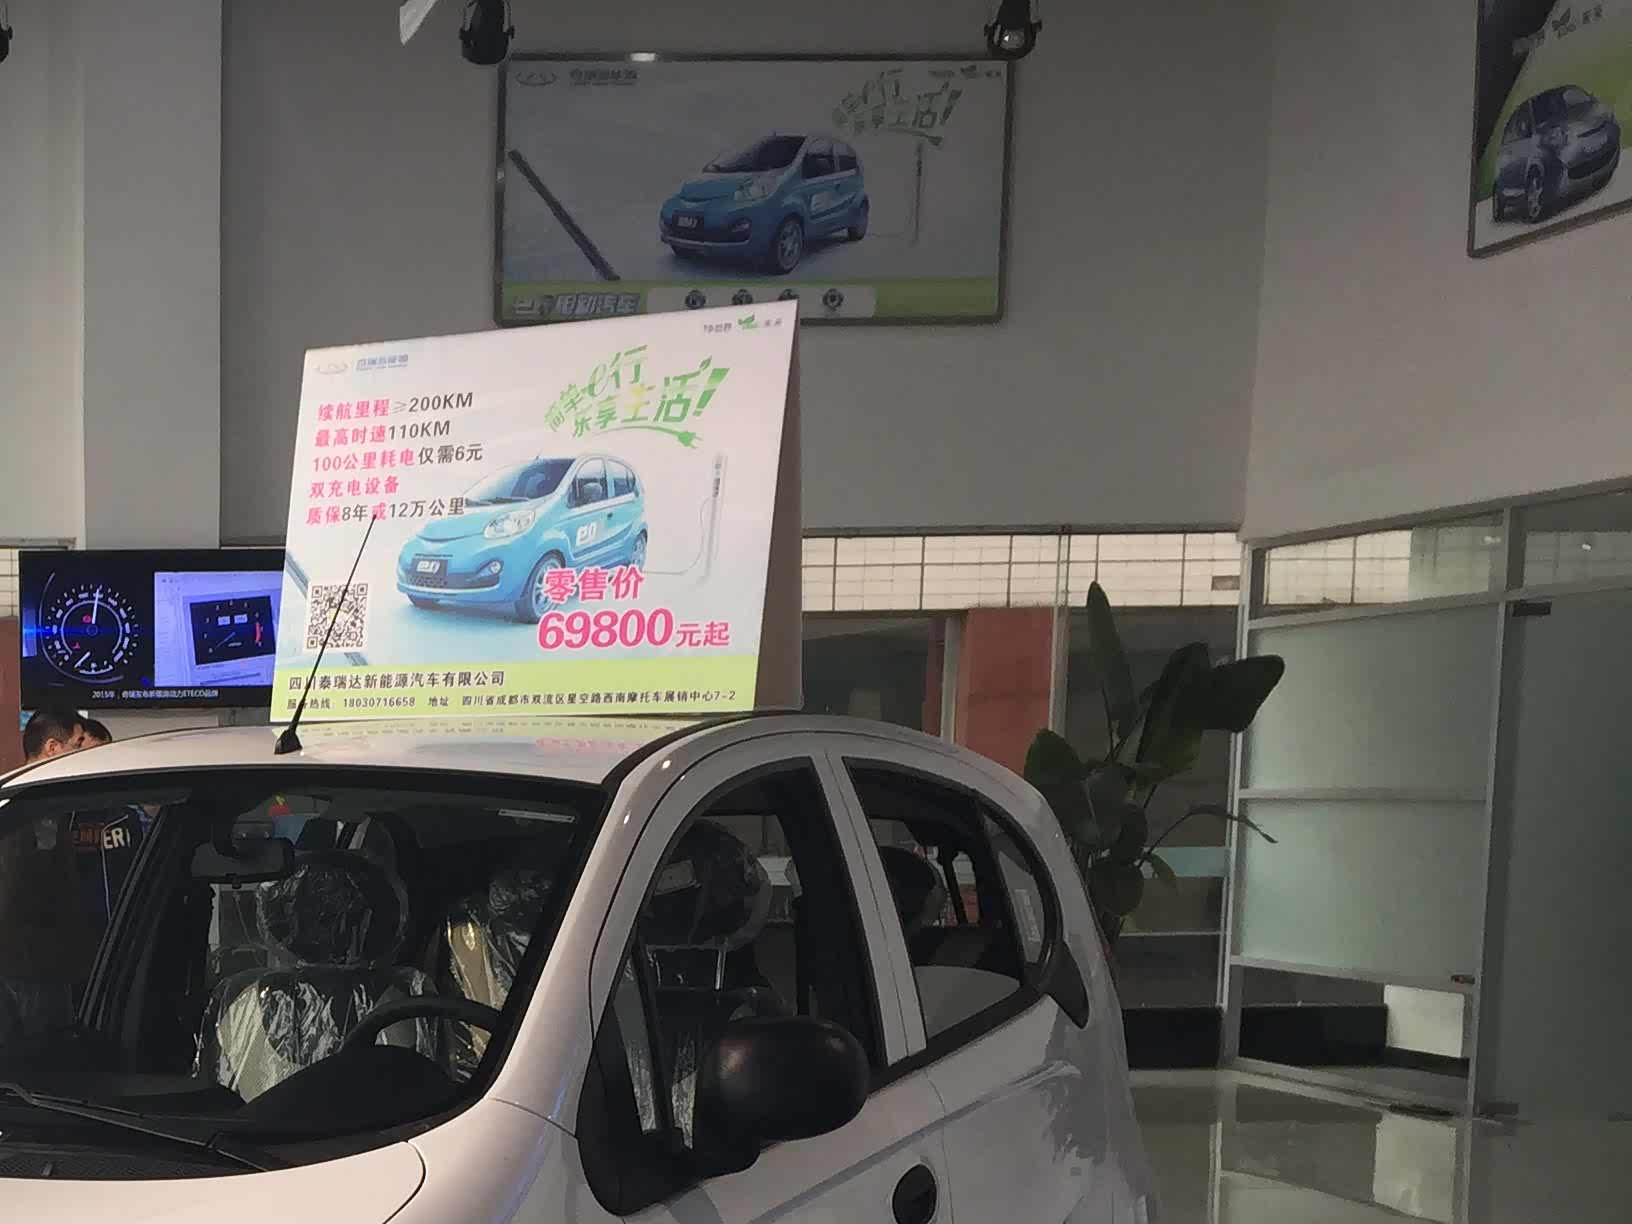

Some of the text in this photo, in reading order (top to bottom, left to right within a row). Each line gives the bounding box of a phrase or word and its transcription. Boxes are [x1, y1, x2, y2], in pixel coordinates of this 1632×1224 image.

[314, 420, 451, 447] 最高时速110KM
[312, 443, 484, 472] 100公里耗电仅需6元
[308, 475, 400, 498] 双充电设备
[306, 496, 466, 525] 质保8年或12万公里
[543, 567, 644, 602] 零售价
